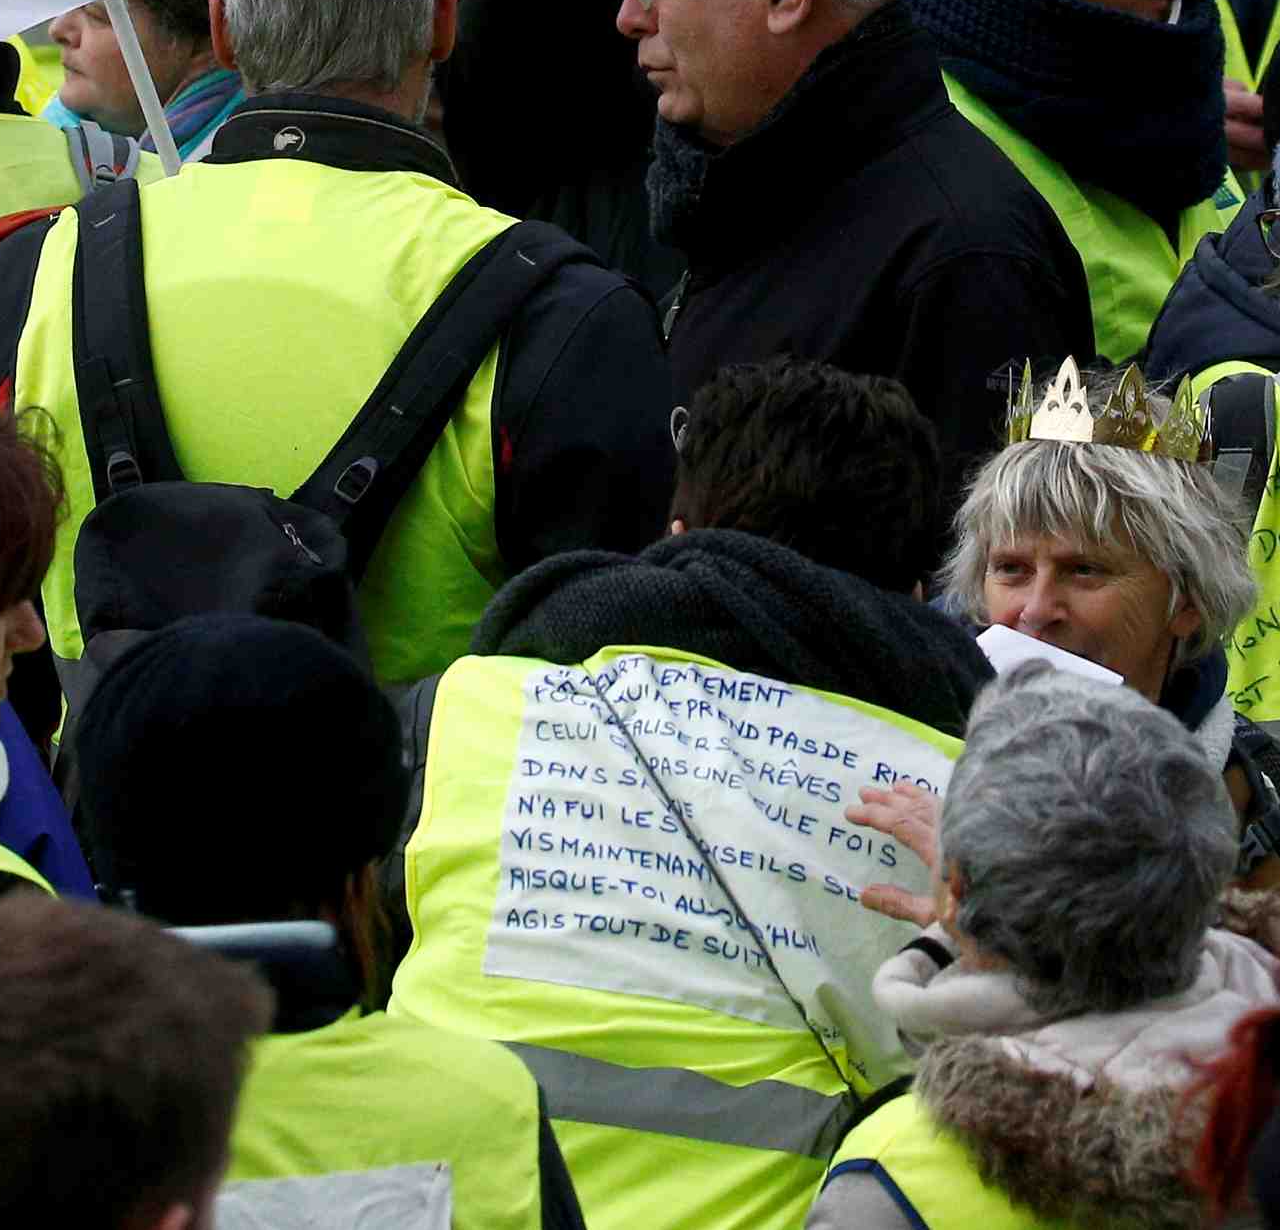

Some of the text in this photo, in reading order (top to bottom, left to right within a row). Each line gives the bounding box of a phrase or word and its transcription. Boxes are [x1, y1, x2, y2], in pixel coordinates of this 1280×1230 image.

[767, 726, 819, 755] PAS
[821, 741, 859, 768] DE
[521, 757, 608, 784] DANS
[760, 758, 842, 804] RÊVES
[536, 719, 597, 742] CELUI
[648, 756, 688, 777] PAS
[694, 766, 743, 789] UNE
[828, 826, 897, 868] FOIS
[518, 795, 556, 819] N'A
[564, 800, 605, 821] FUI
[621, 806, 679, 834] LES
[510, 827, 554, 852] VIS
[510, 868, 666, 904] RISQUE-TOI
[506, 908, 565, 930] AGIS
[574, 913, 645, 938] TOUT
[650, 923, 692, 950] DE
